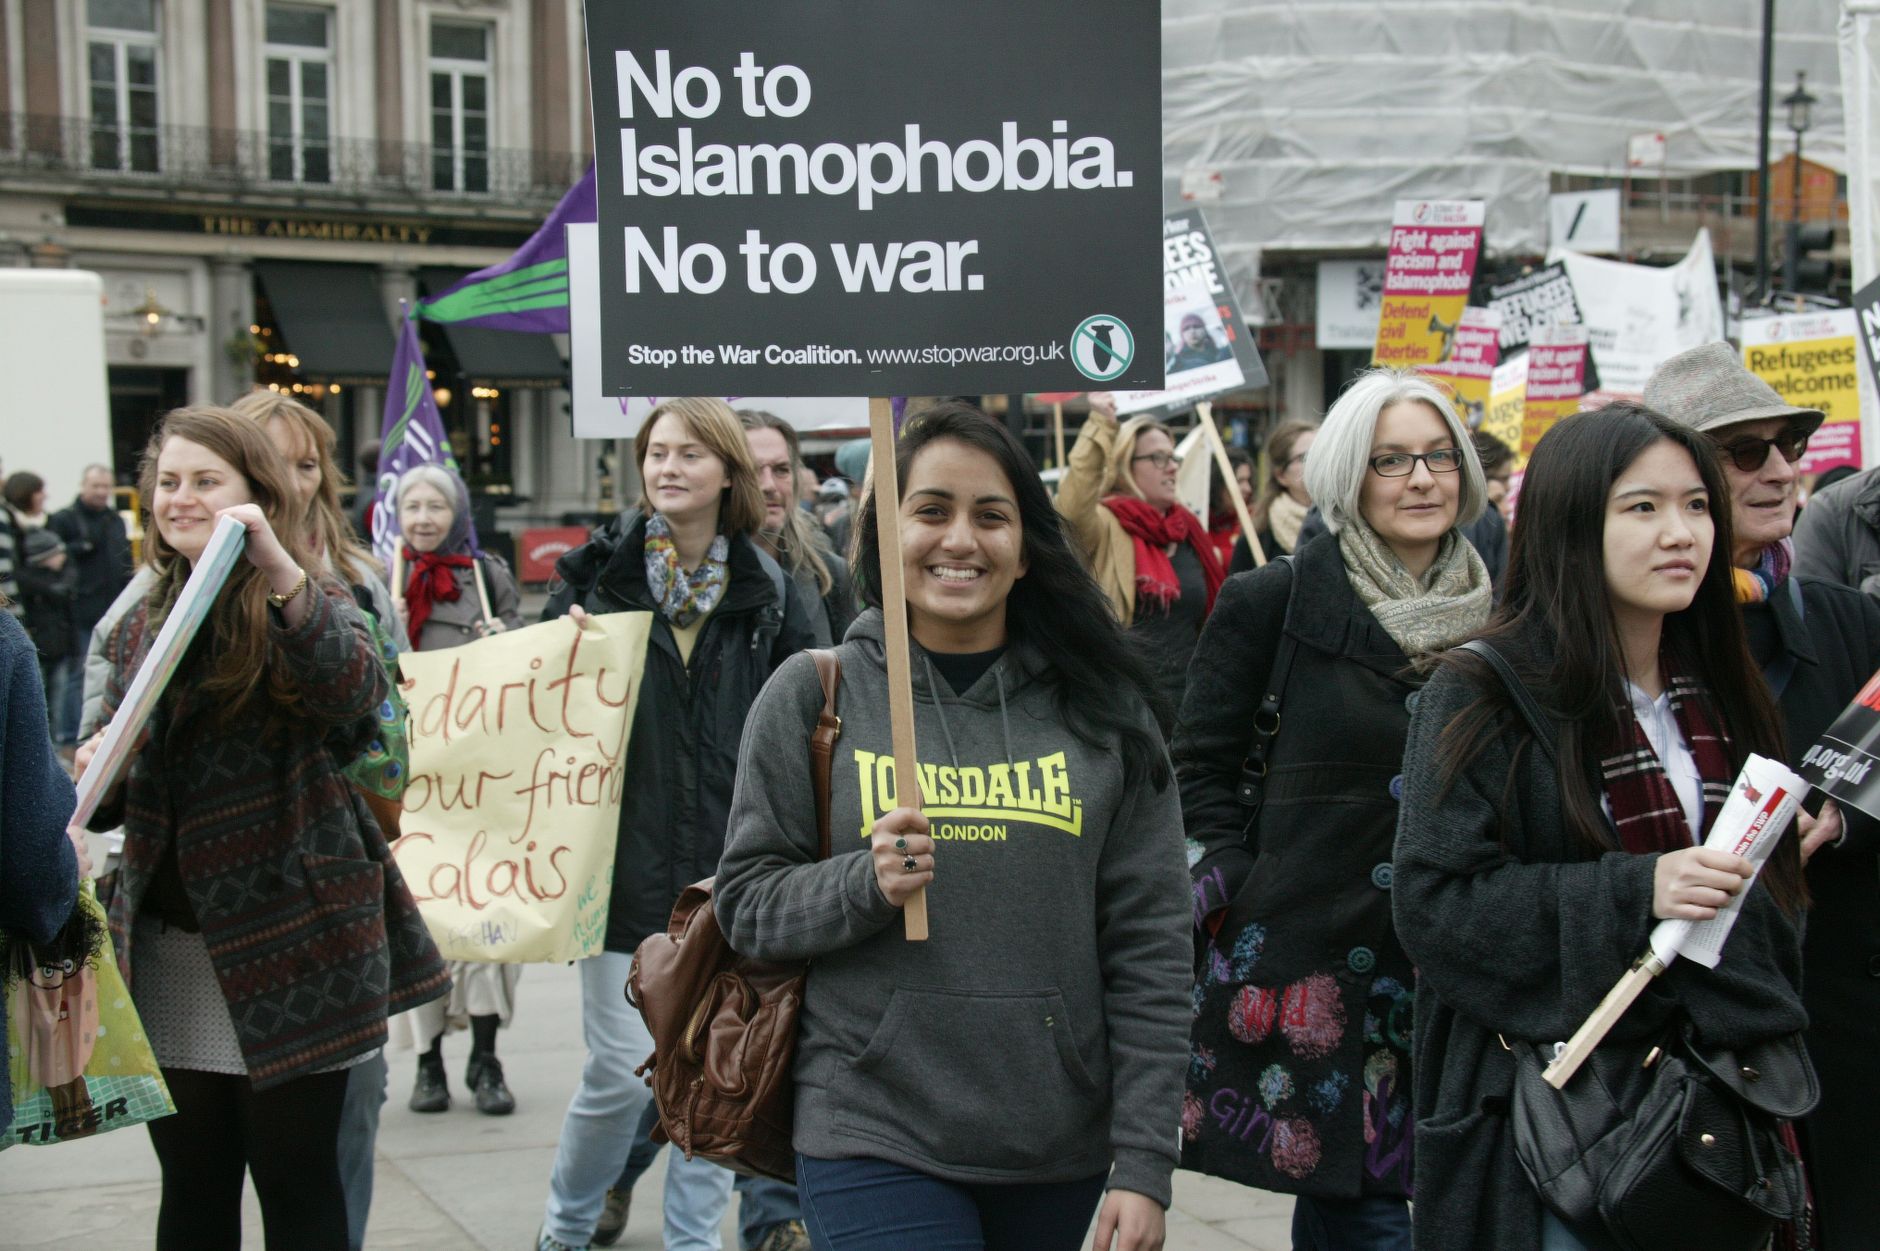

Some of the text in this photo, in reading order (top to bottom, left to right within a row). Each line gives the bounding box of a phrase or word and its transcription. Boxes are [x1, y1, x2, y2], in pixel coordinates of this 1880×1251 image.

[615, 49, 812, 119] No to
[620, 119, 1134, 211] Islamophobia.
[204, 215, 431, 243] THE ADMIRALTY
[1392, 229, 1476, 254] Fight against
[624, 226, 985, 295] No to war.
[1389, 251, 1464, 270] racism and
[1383, 302, 1430, 319] Defend
[1380, 323, 1407, 339] civil
[628, 340, 1065, 368] Stop the War Coalition. www.stopwar.org.uk
[1375, 344, 1429, 360] liberties
[1751, 347, 1855, 373] Refugees
[1769, 372, 1854, 396] elcome
[930, 824, 1008, 841] LONDON
[1744, 829, 1759, 842] the
[1754, 811, 1769, 830] SWP
[16, 1097, 129, 1143] TIGER
